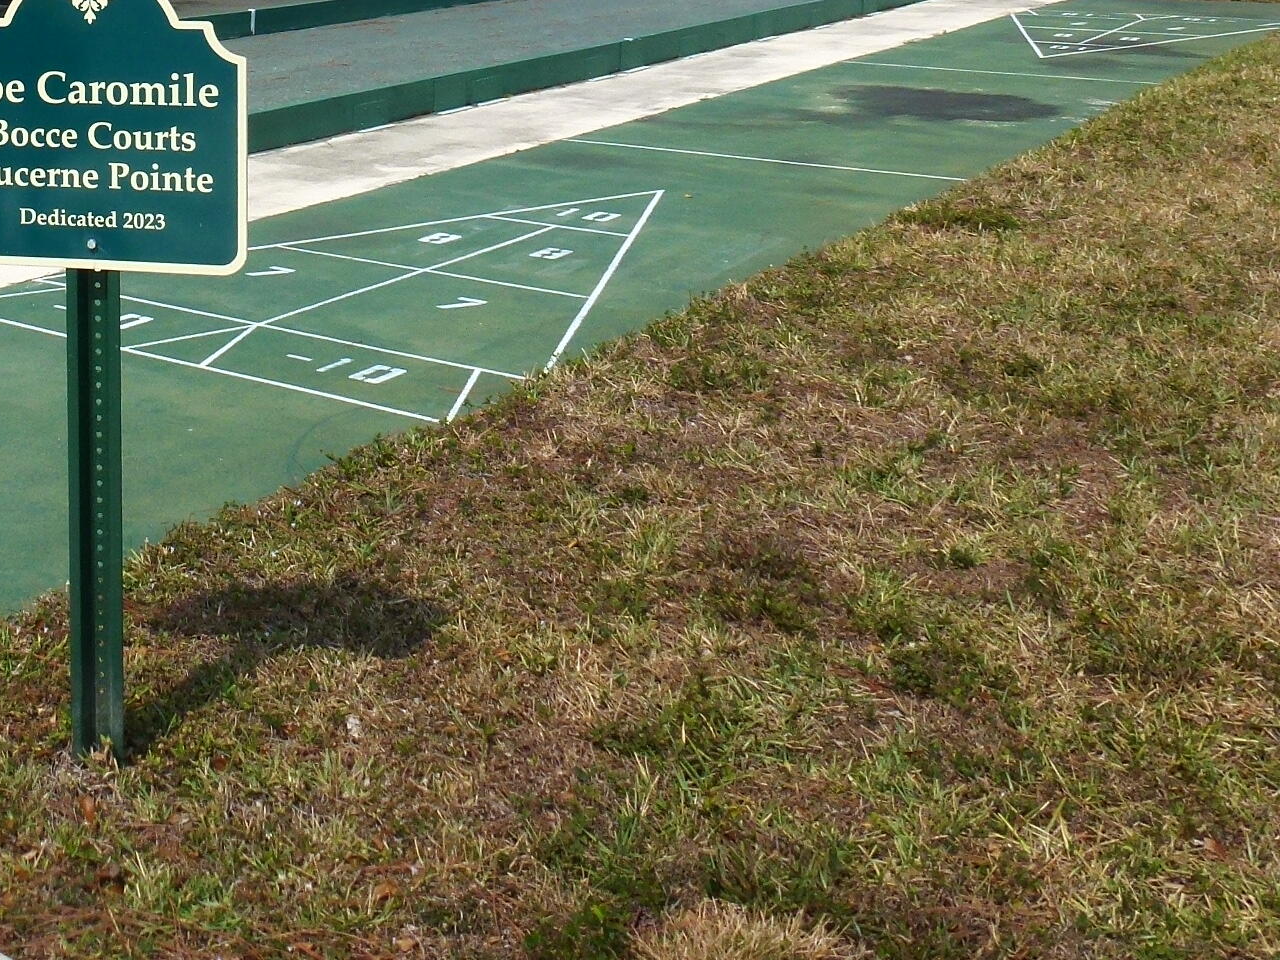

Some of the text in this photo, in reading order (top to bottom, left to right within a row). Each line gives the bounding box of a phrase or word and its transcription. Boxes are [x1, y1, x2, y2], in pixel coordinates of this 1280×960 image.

[37, 70, 219, 108] Caromile
[87, 122, 196, 152] Courts
[108, 162, 214, 193] Pointe
[19, 207, 166, 230] Dedicated 2023
[556, 207, 622, 222] 10
